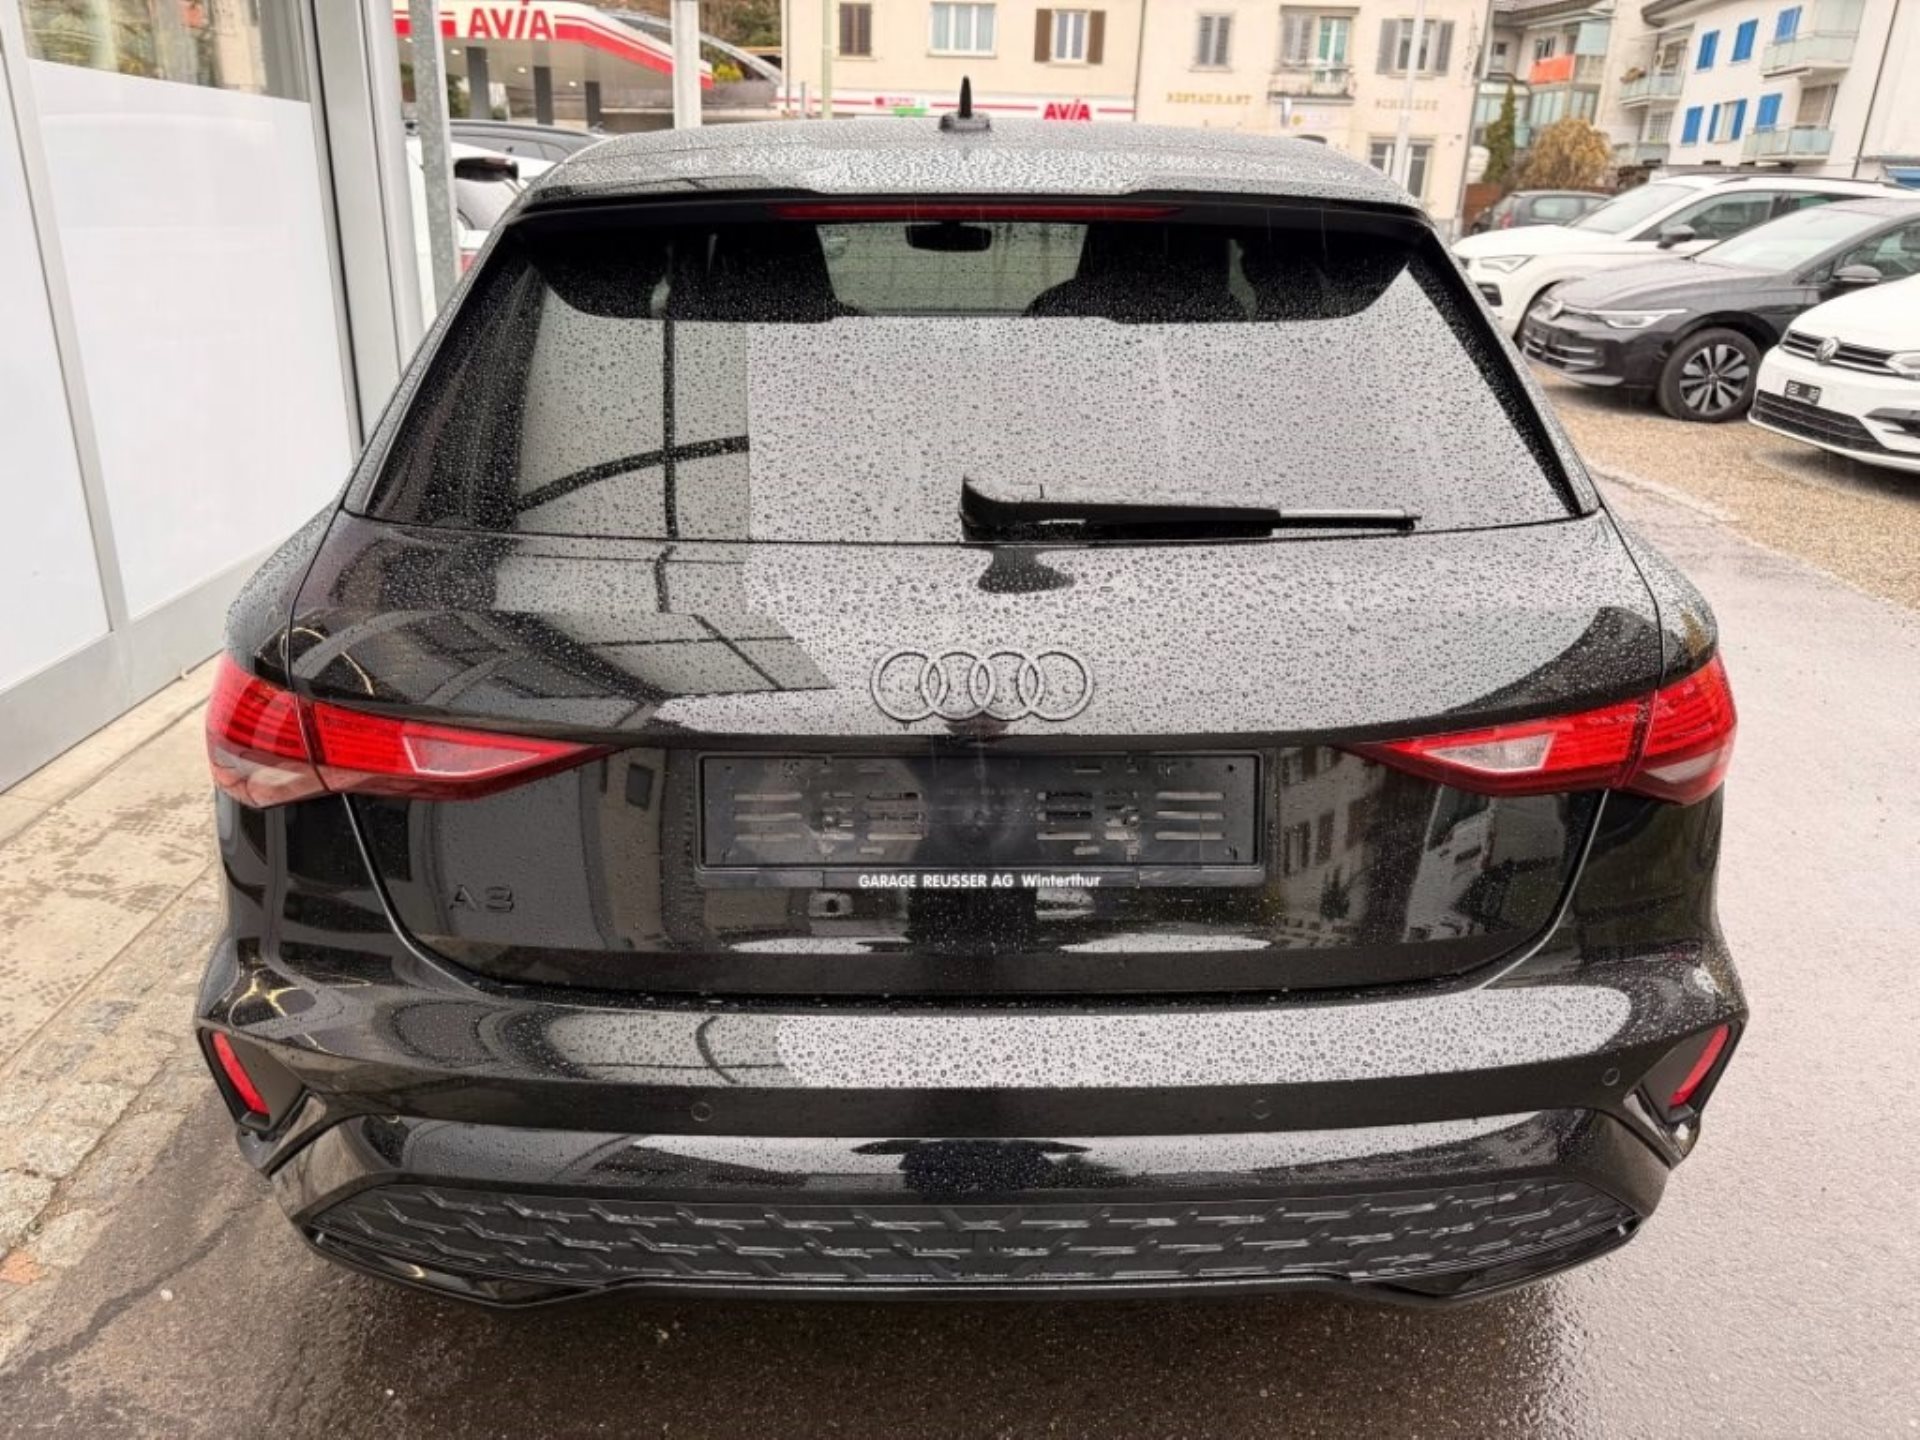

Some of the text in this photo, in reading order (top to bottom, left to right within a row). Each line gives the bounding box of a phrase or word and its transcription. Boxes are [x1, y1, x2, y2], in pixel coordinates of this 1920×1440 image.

[469, 0, 553, 39] AVIA
[1044, 97, 1091, 120] AVIA
[858, 873, 1102, 888] GARAGE REUSSER AG Winterthur
[449, 884, 514, 912] A3
